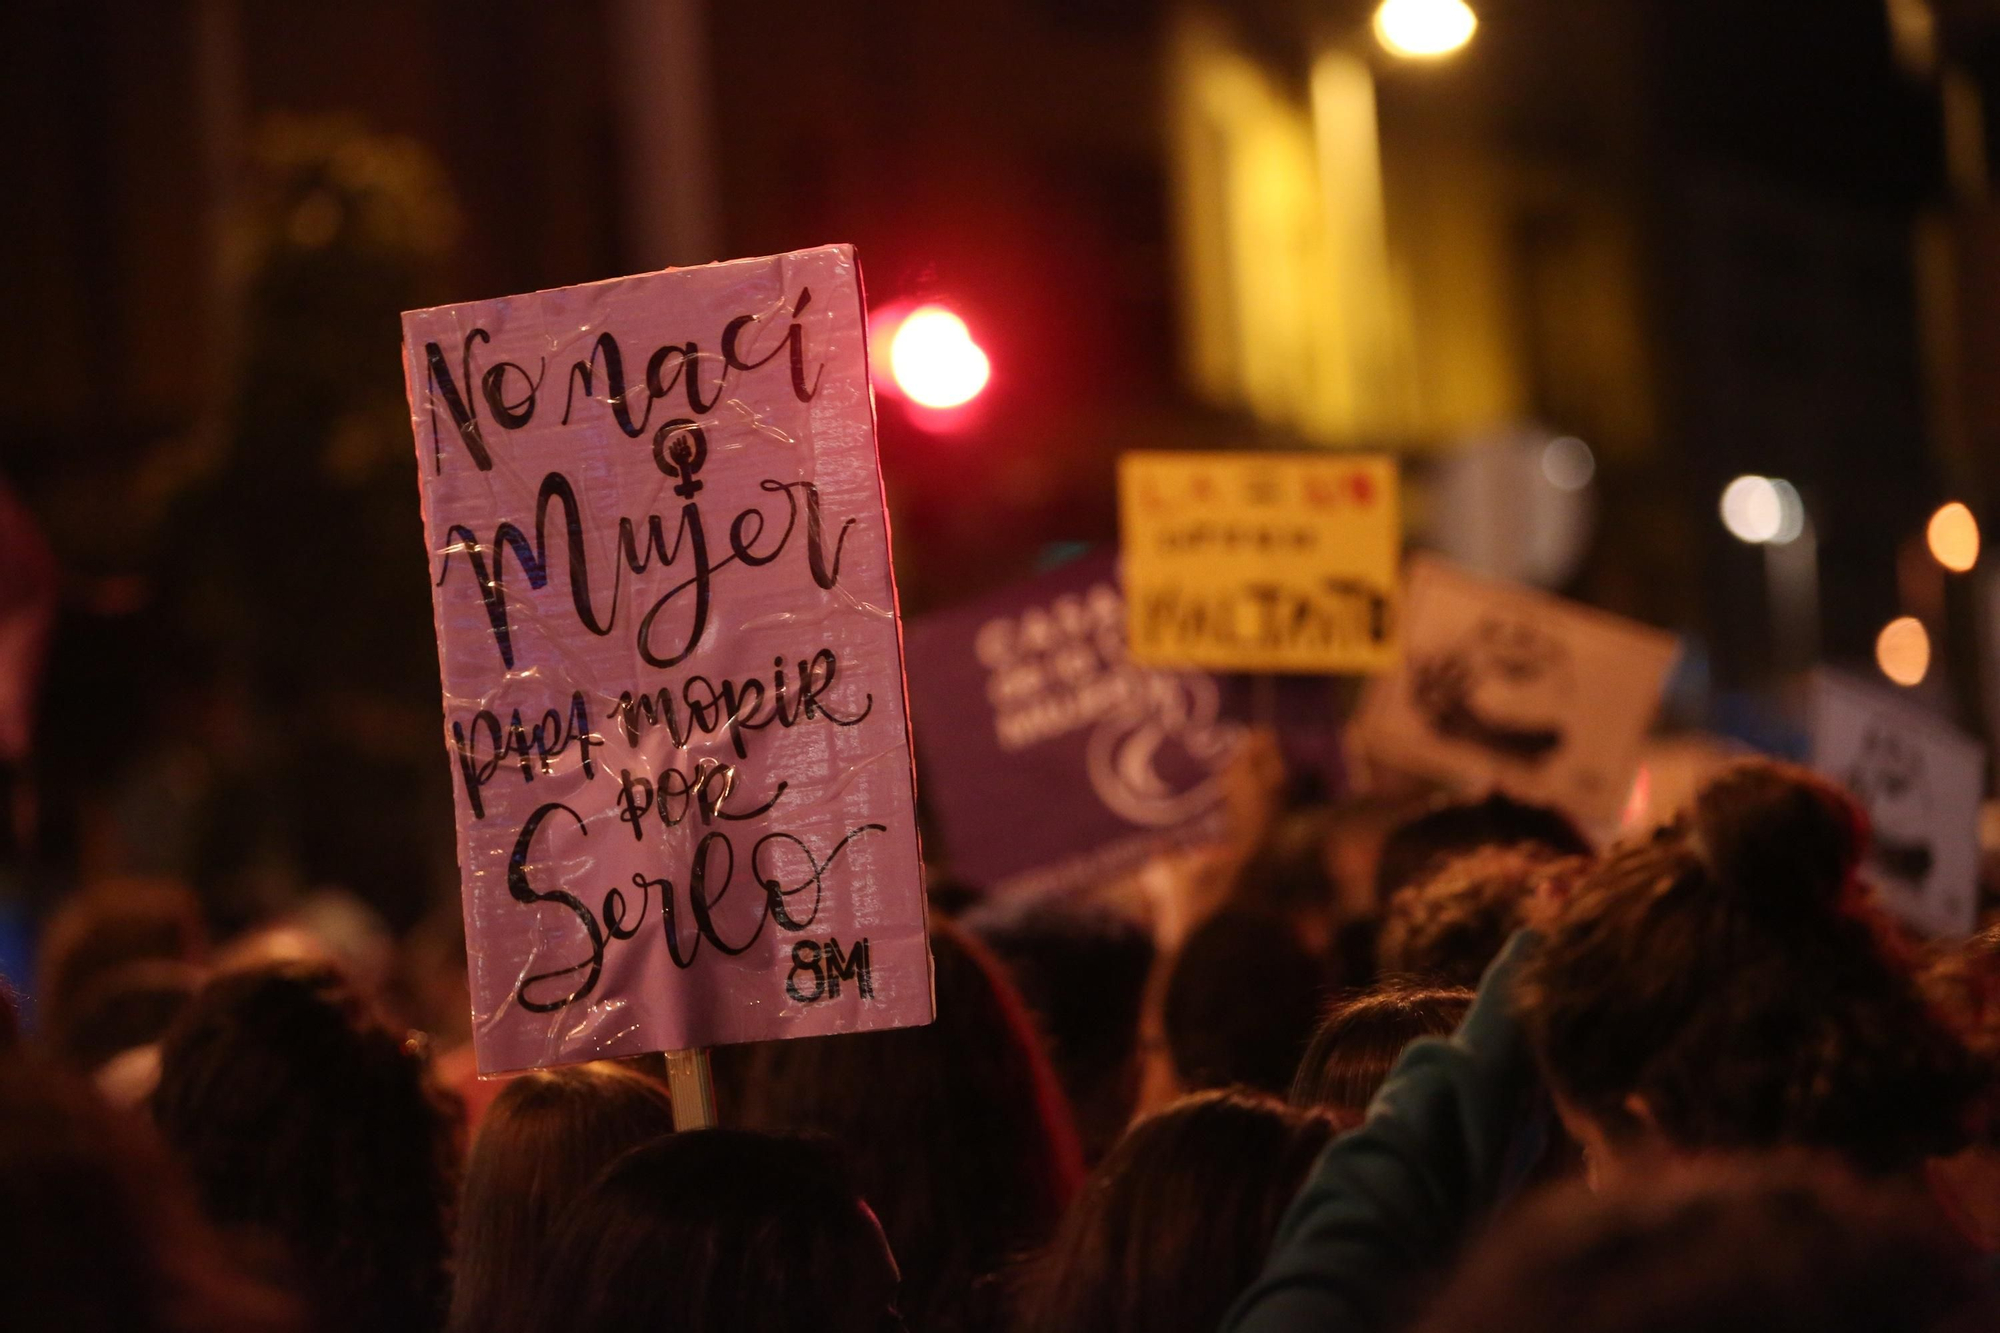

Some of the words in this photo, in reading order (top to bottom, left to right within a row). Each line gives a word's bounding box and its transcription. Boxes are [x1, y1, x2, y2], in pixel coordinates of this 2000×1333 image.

[426, 328, 542, 475] No
[436, 472, 856, 668] Mujer
[508, 802, 887, 1014] Serlo
[785, 938, 876, 1002] 8M
